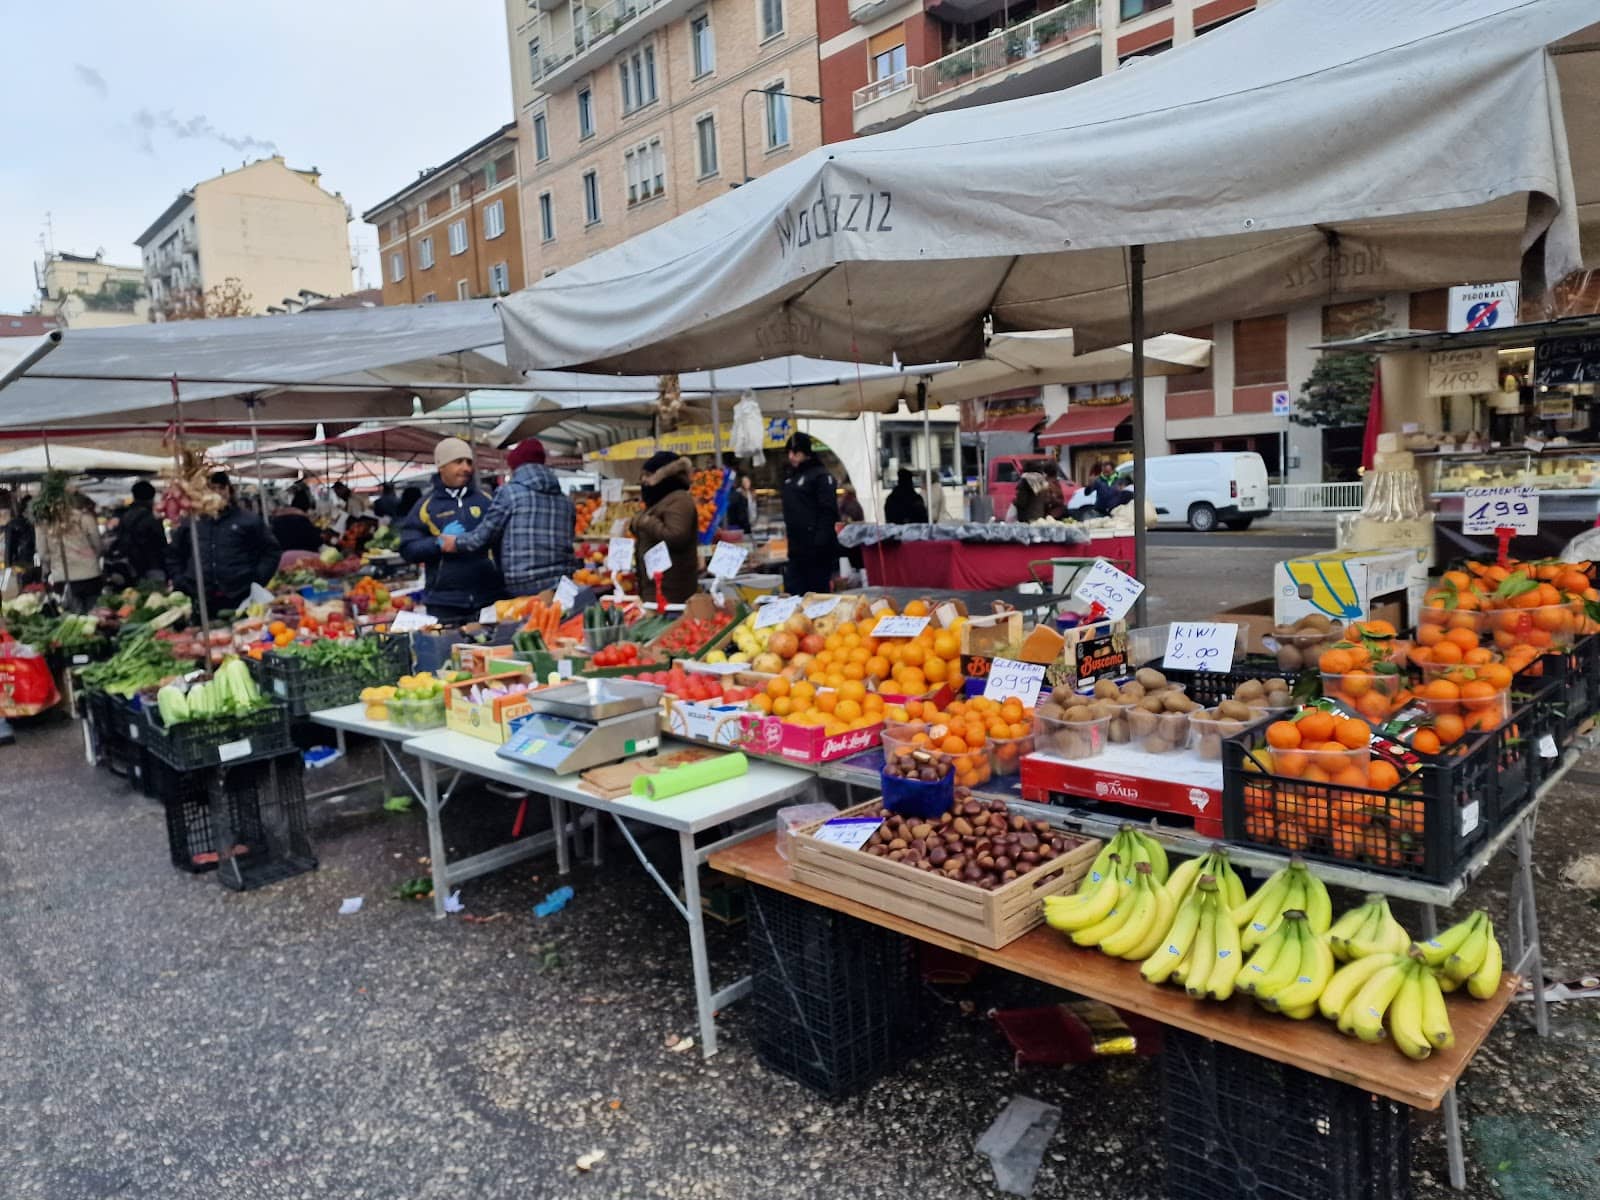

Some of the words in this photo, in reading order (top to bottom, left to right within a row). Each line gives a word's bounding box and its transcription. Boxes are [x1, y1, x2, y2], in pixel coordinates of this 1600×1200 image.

[1465, 486, 1535, 498] CLEMENTINI
[1095, 562, 1119, 579] UVA
[821, 735, 848, 759] Pink
[848, 730, 872, 749] Lady
